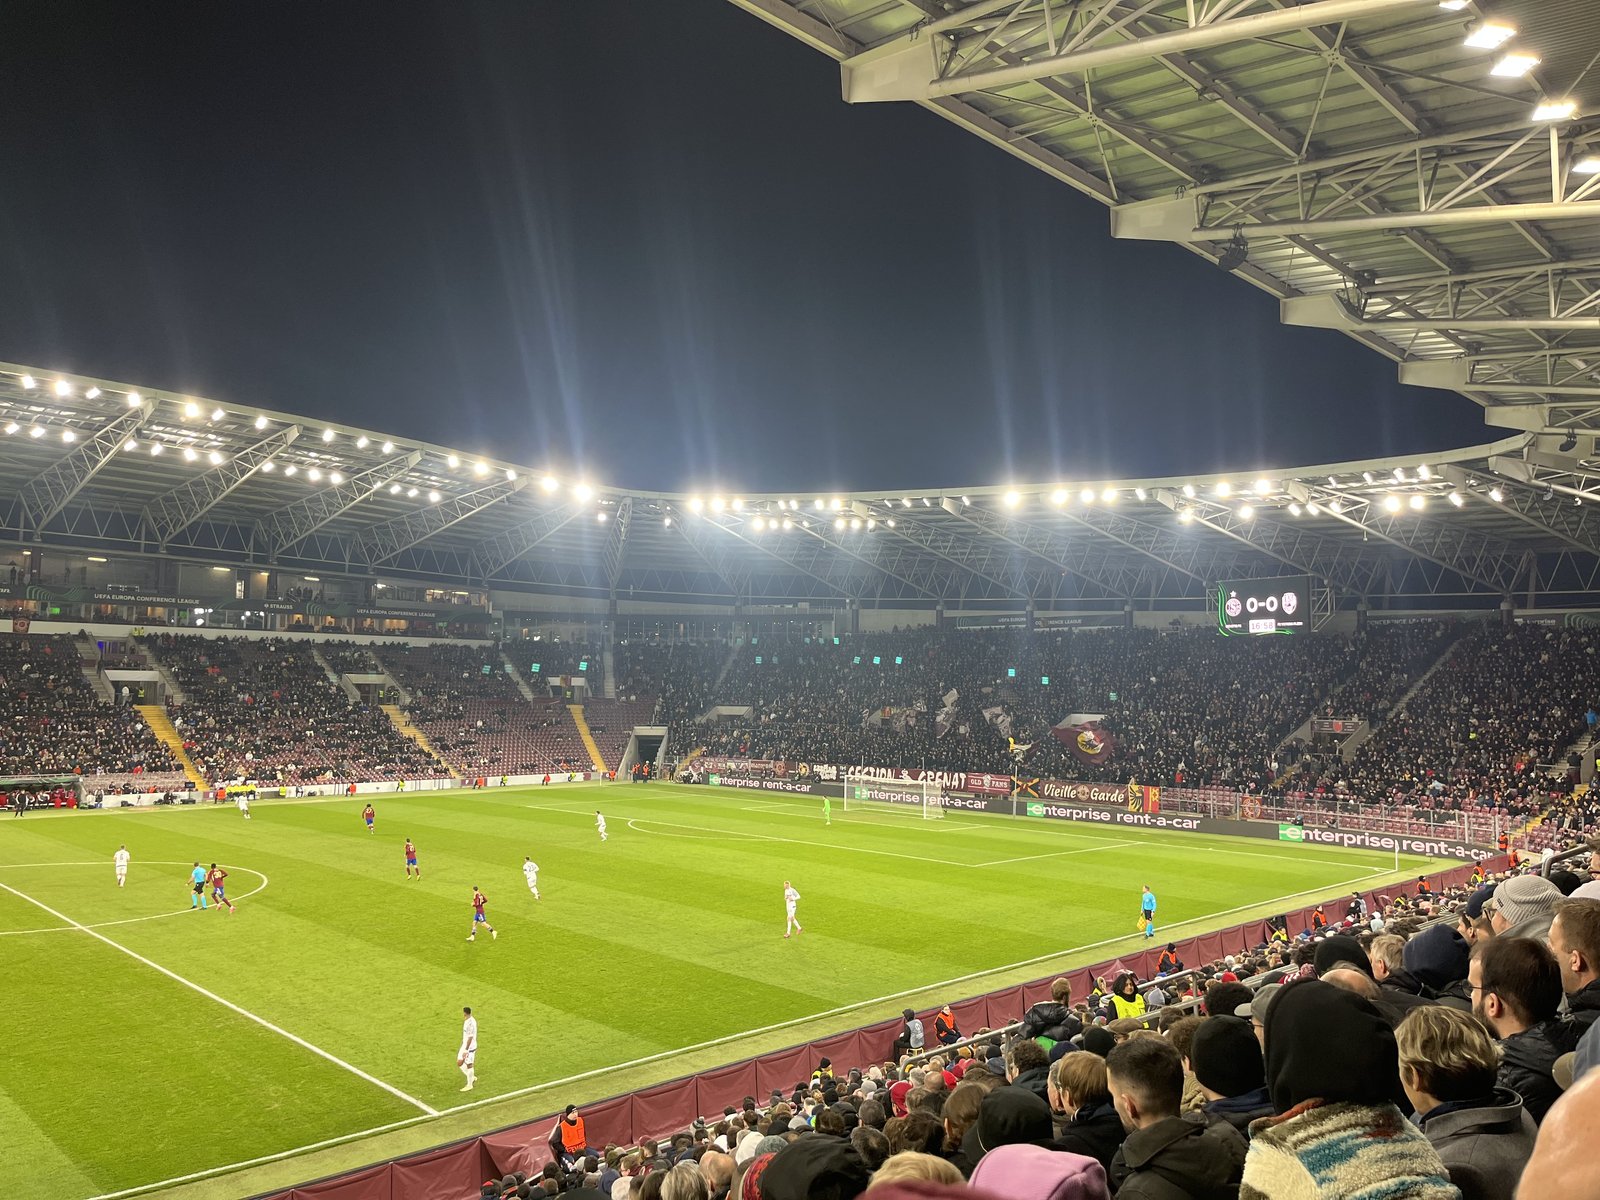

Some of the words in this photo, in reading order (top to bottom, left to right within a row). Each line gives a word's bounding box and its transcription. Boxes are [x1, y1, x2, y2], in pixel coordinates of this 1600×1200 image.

[136, 595, 176, 604] CONFERENCE
[1246, 596, 1278, 613] 0-0
[713, 776, 760, 788] enterprise
[762, 781, 812, 792] rent-a-car
[991, 780, 1008, 788] FANS
[1044, 783, 1077, 799] Vieille
[1090, 787, 1125, 802] Garde
[861, 787, 920, 804] enterprise
[924, 793, 988, 809] rent-a-car
[1031, 804, 1111, 821] enterprise
[1116, 813, 1201, 829] rent-a-car
[1286, 827, 1395, 847] enterprise
[1402, 839, 1494, 861] rent-a-car
